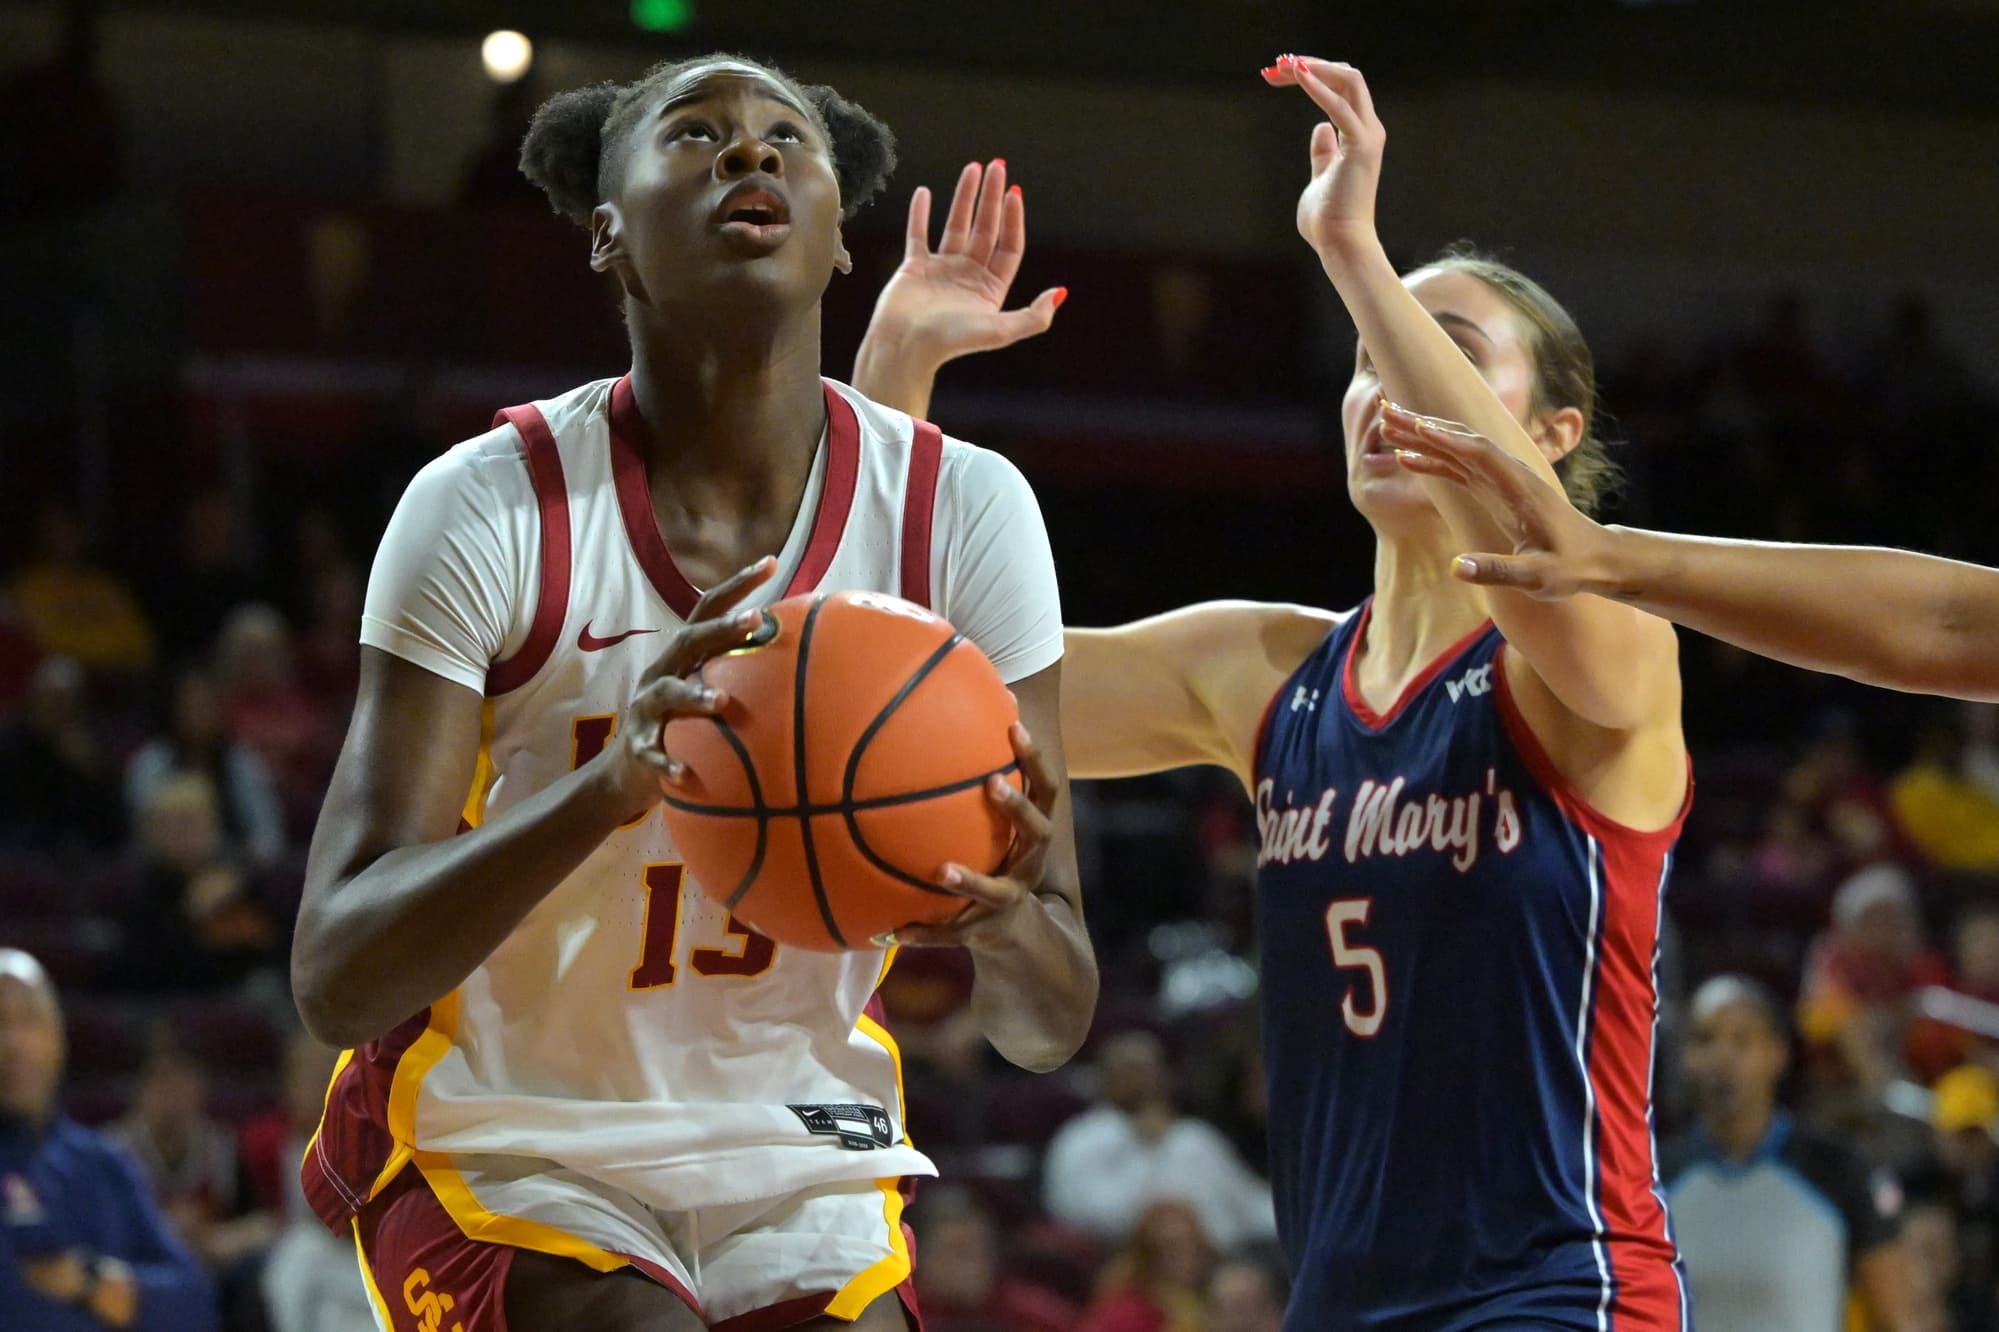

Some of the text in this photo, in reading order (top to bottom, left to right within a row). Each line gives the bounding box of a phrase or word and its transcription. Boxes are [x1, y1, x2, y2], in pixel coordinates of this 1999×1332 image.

[1257, 768, 1521, 873] Saint Mary's
[1327, 897, 1387, 1036] 5
[873, 1116, 888, 1134] 46
